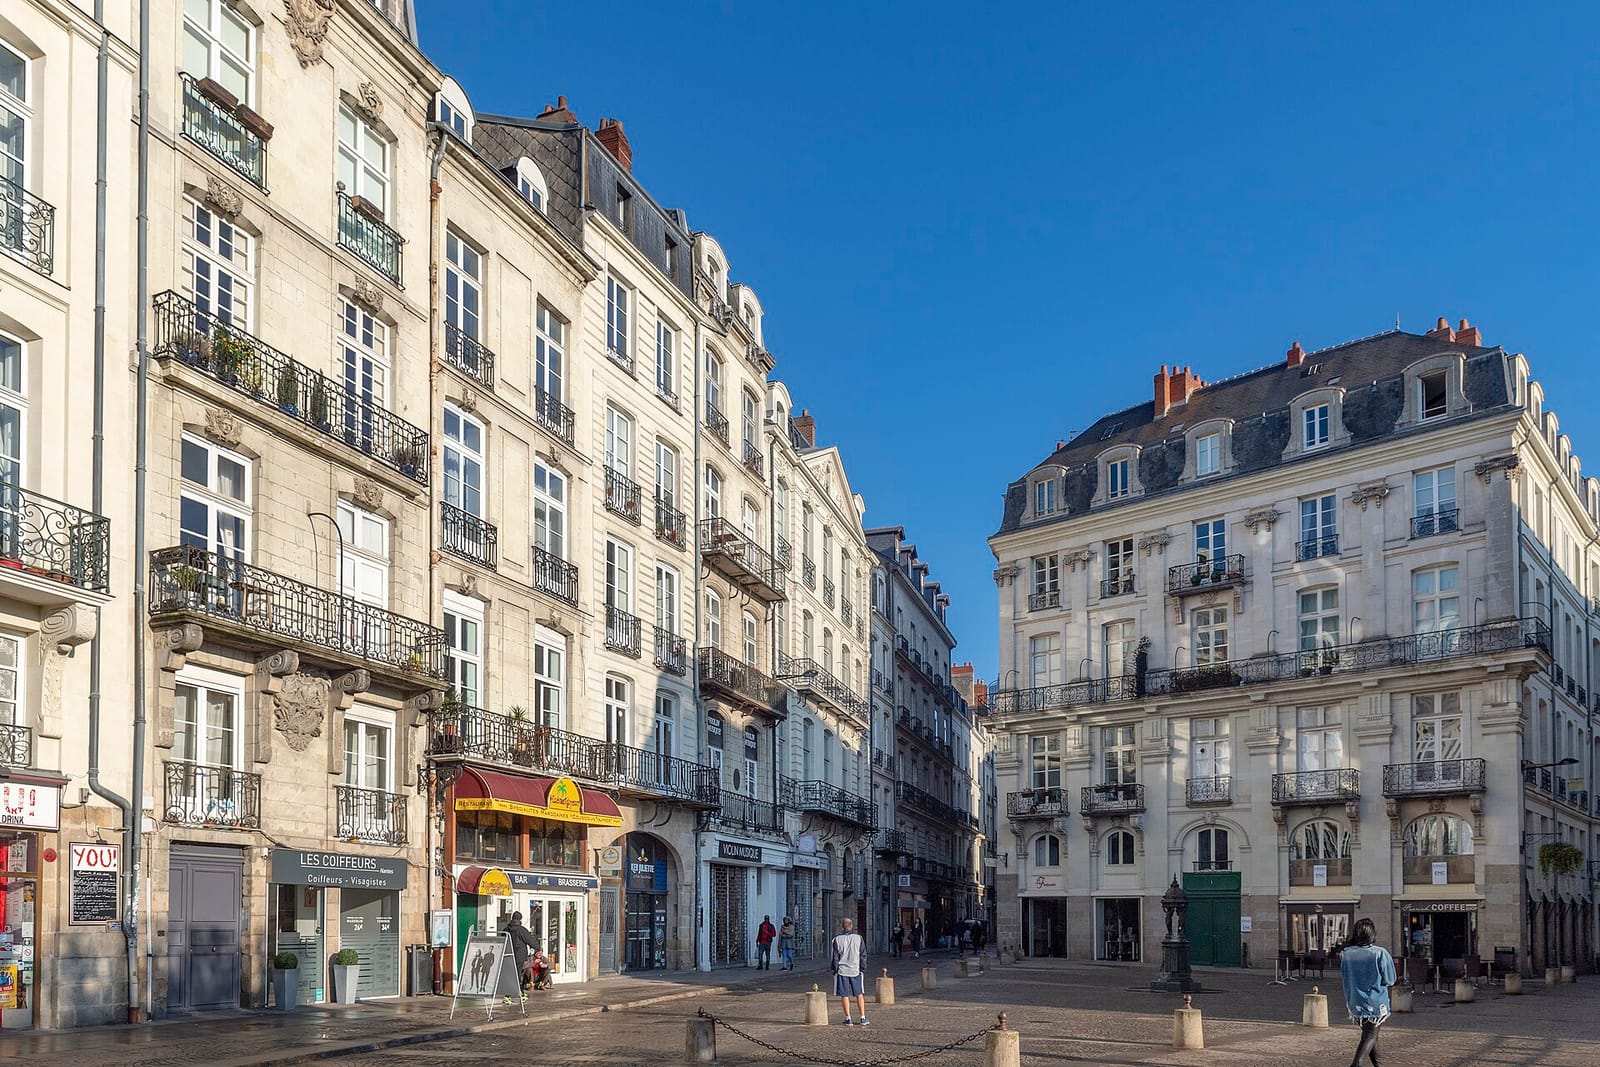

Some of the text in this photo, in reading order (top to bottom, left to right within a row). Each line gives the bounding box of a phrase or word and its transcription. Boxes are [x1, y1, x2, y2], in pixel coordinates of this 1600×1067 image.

[2, 815, 24, 824] DRINK
[74, 848, 116, 868] YOU!
[722, 843, 759, 860] VIOLIN MUSIQUE
[300, 853, 377, 869] LES COIFFEURS
[307, 873, 387, 888] Coiffeurs Visagistes
[514, 875, 528, 884] BAR
[557, 877, 588, 888] BRASSERIE
[1431, 903, 1466, 911] COFFEE
